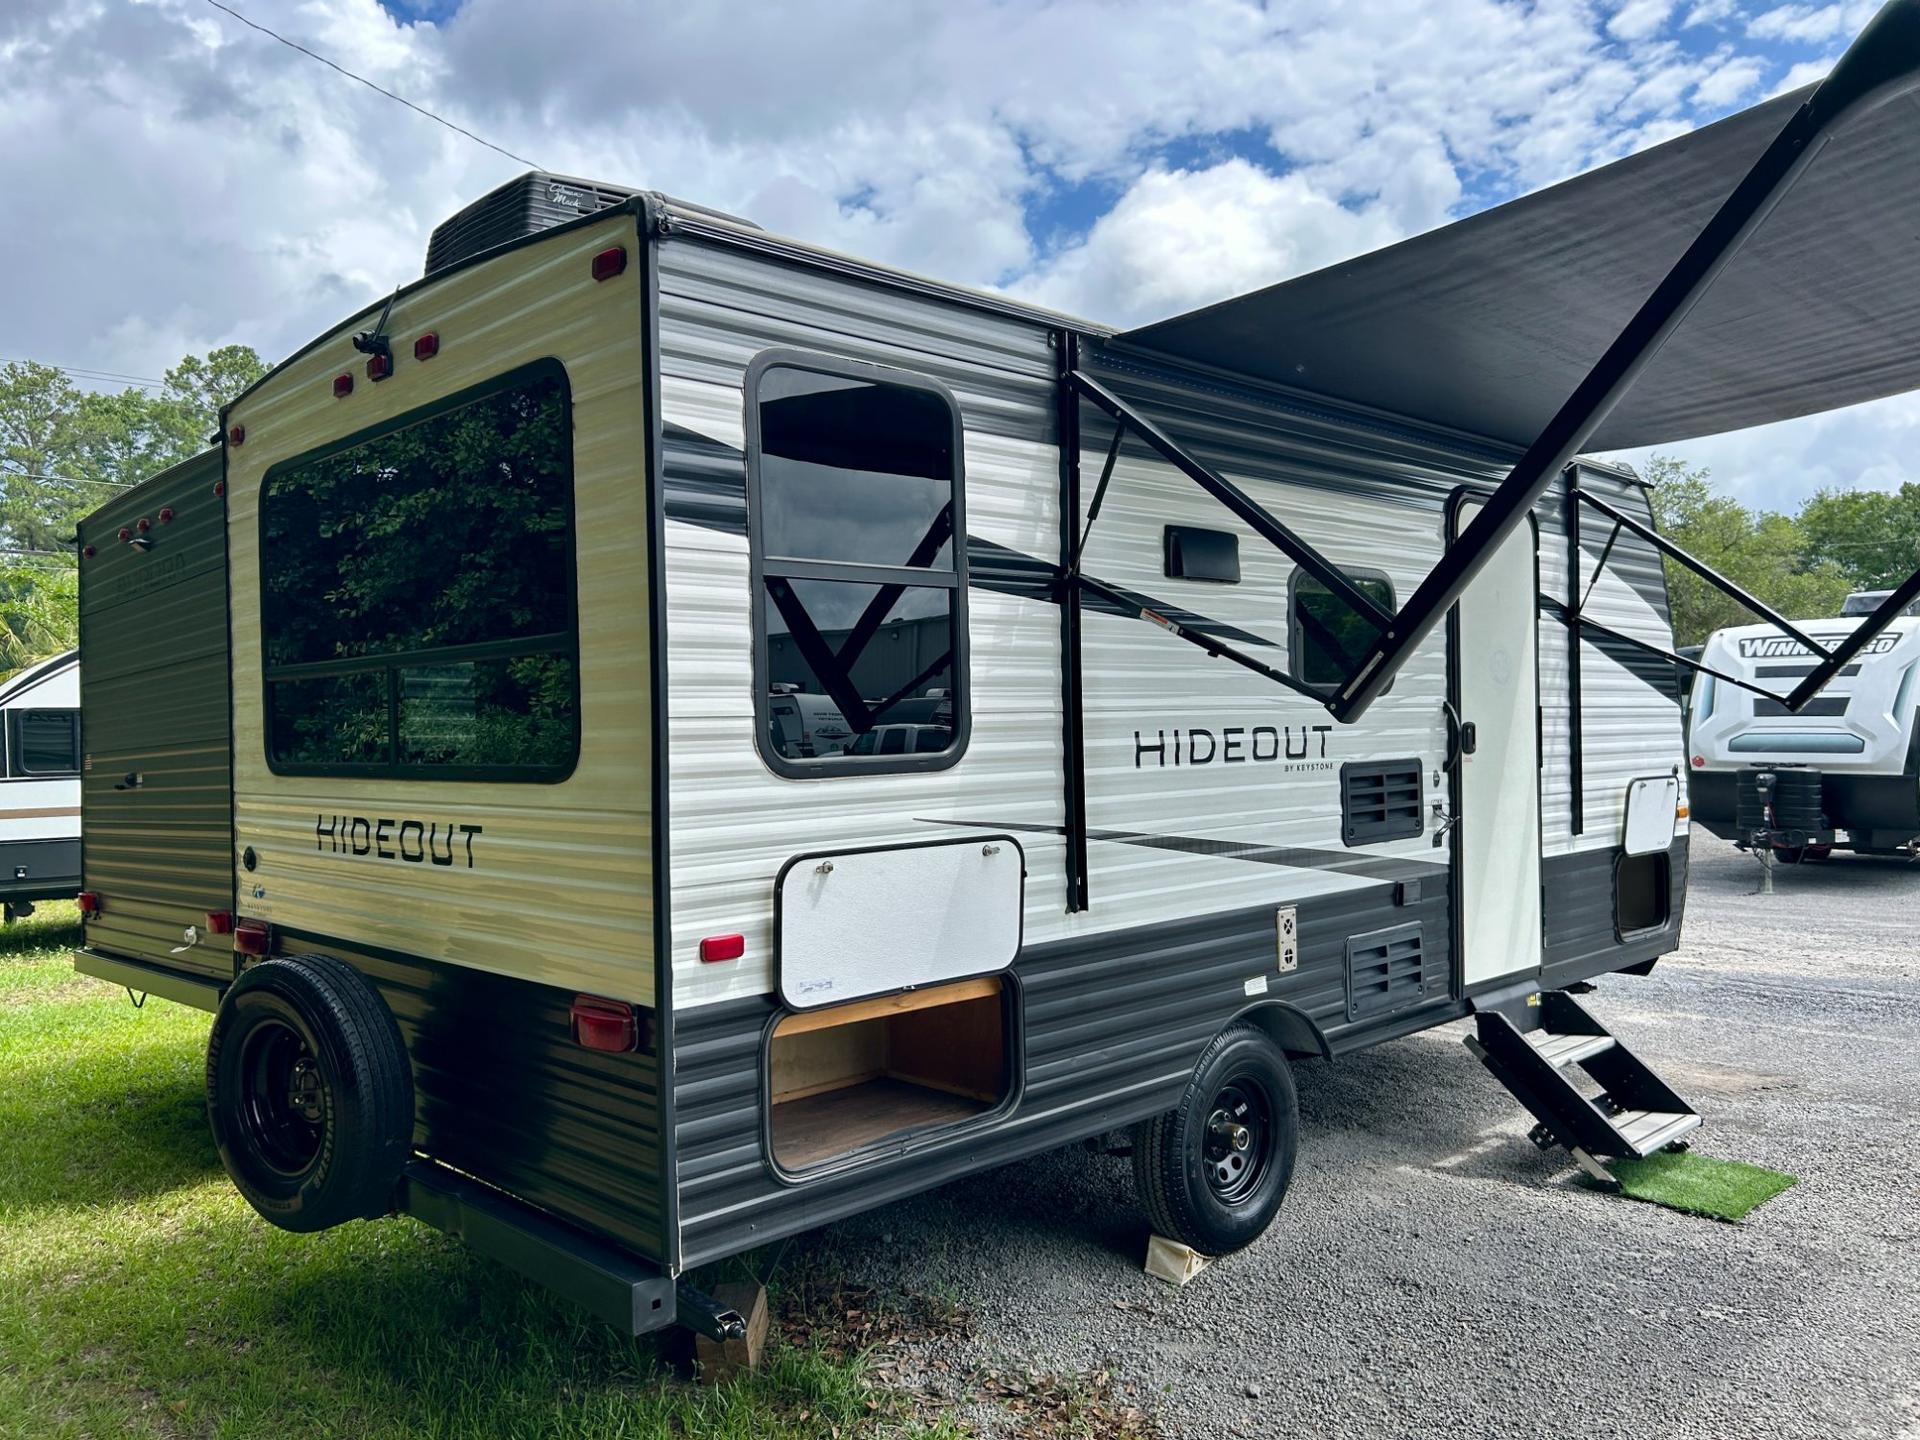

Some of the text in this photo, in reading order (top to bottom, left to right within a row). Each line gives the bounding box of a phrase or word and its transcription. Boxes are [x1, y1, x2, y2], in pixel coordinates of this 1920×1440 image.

[1134, 725, 1332, 768] HIDEOUT
[1284, 762, 1334, 772] BY KEYSTONE
[316, 814, 483, 869] HIDEOUT
